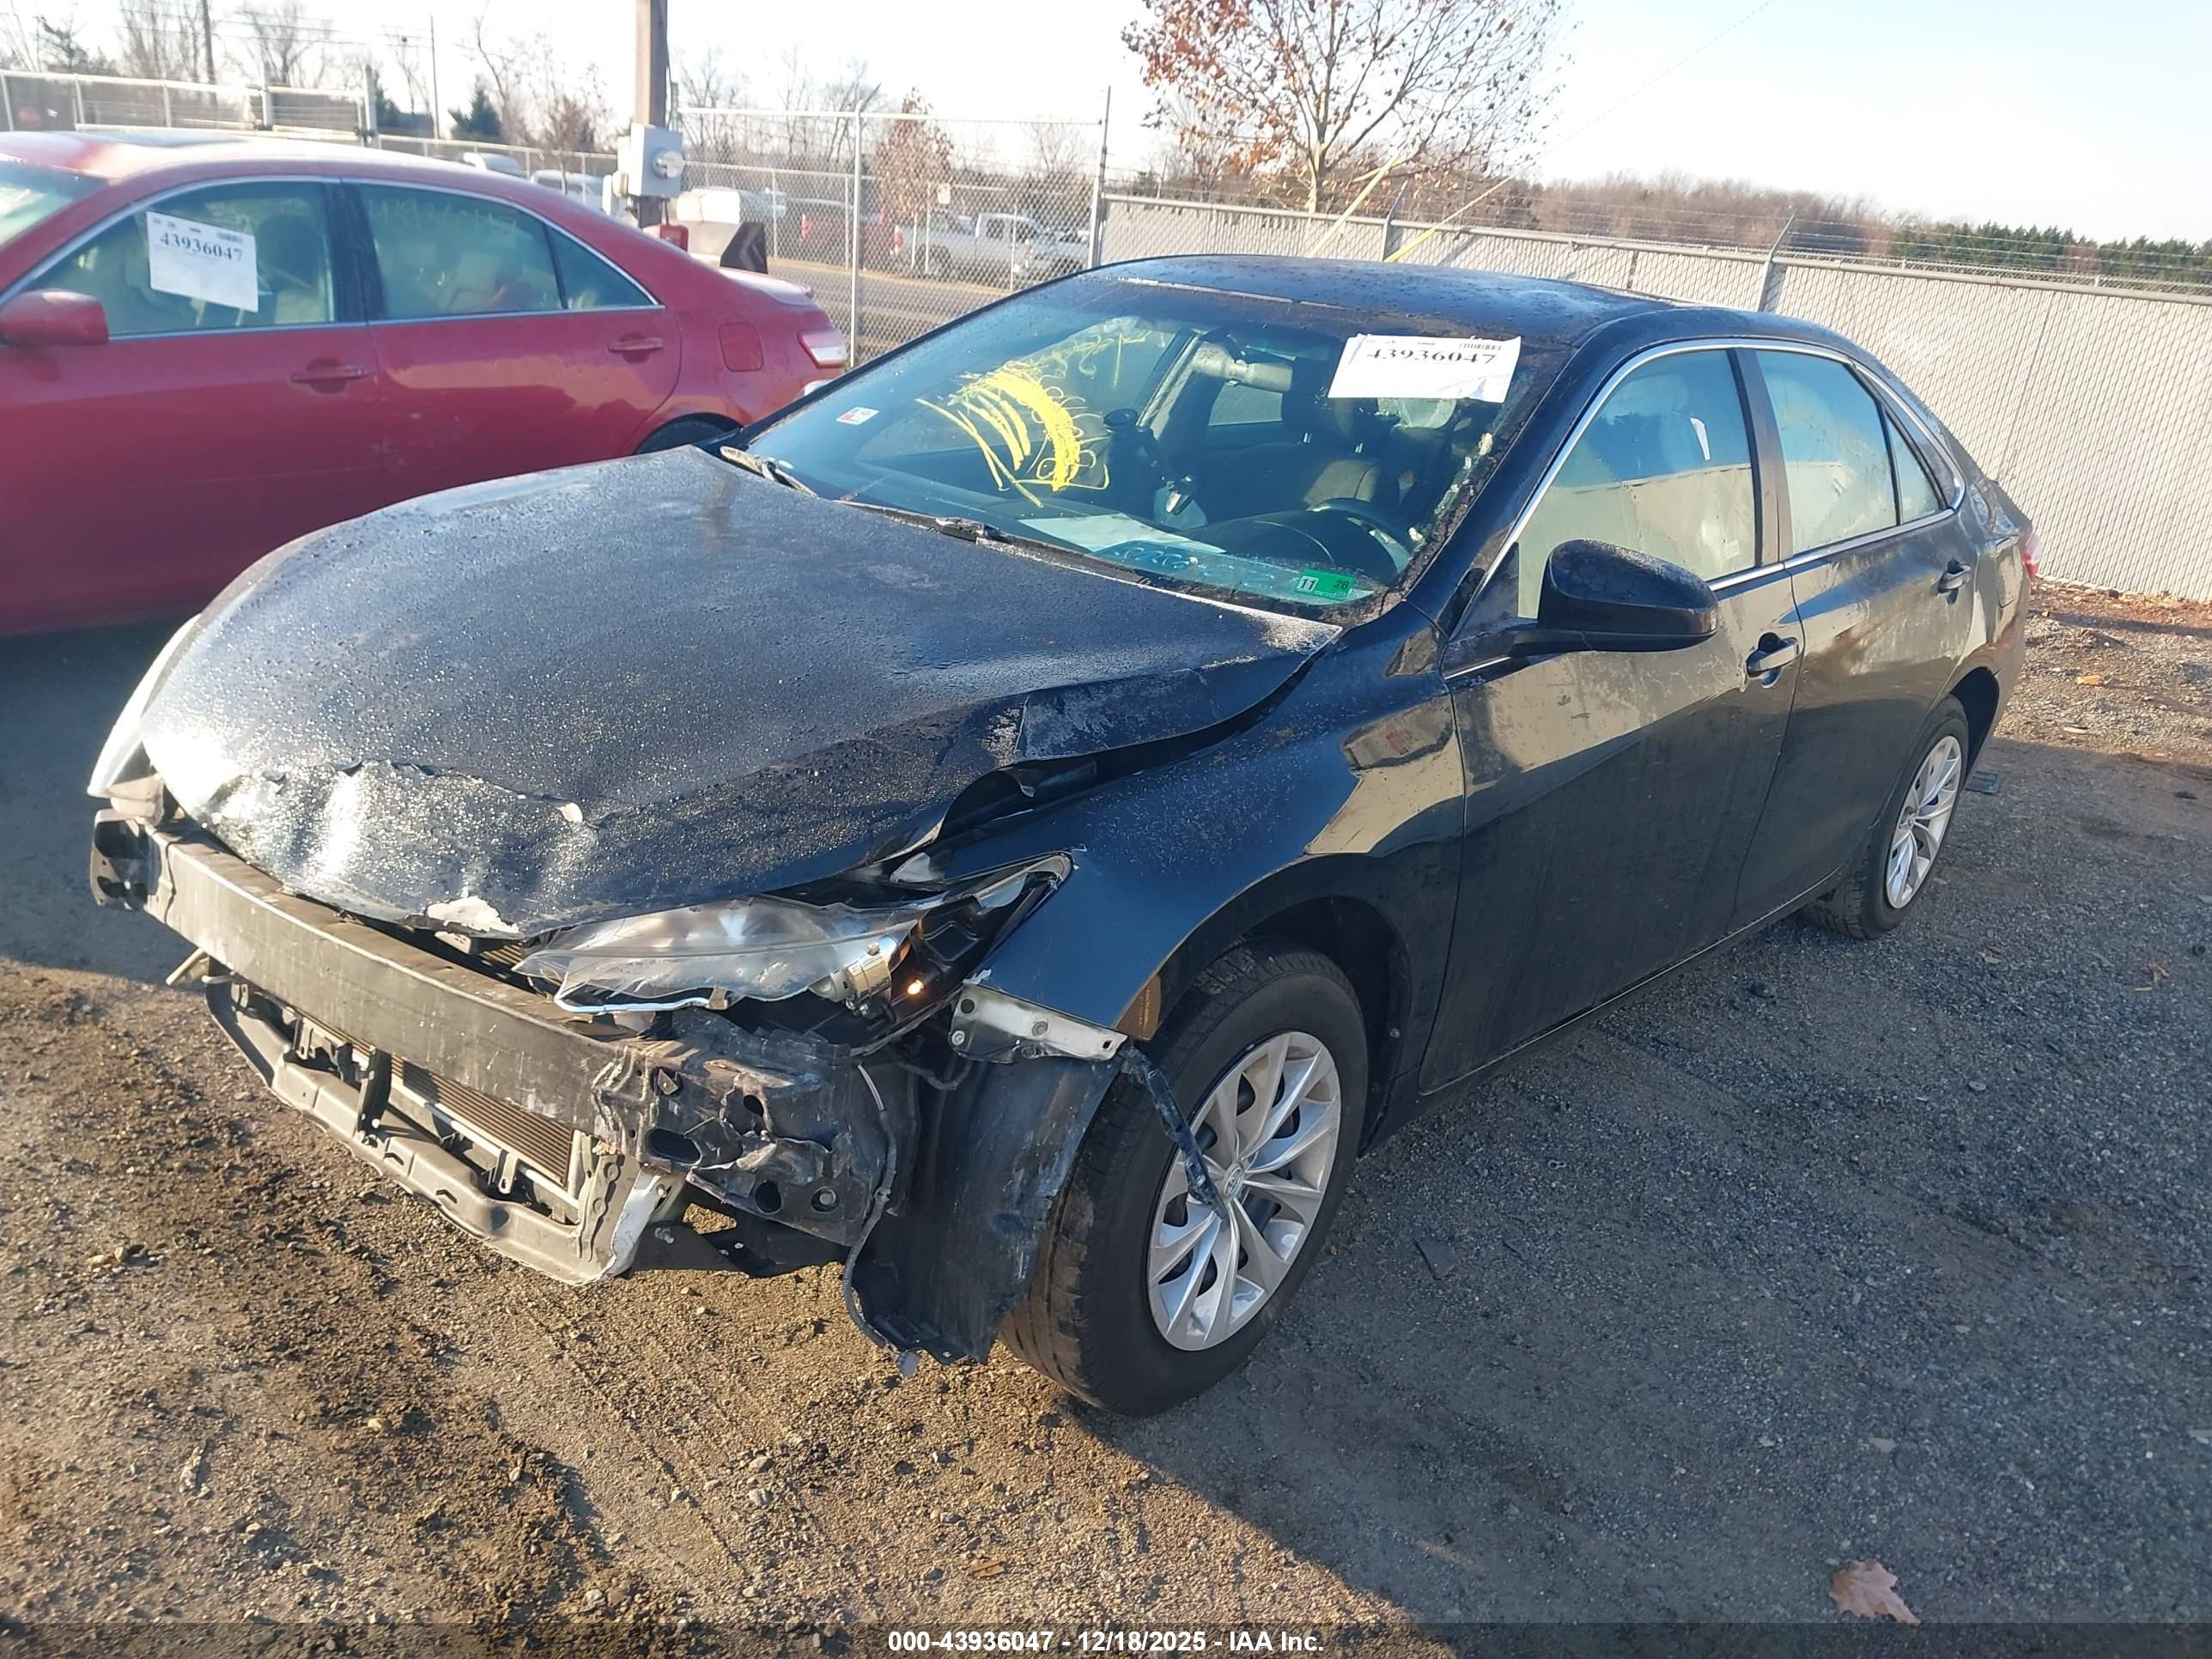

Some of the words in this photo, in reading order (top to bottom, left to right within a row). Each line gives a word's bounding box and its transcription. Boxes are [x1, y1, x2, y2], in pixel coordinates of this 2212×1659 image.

[160, 232, 243, 262] 43936047
[1367, 349, 1497, 364] 43936047
[1301, 578, 1316, 591] 11
